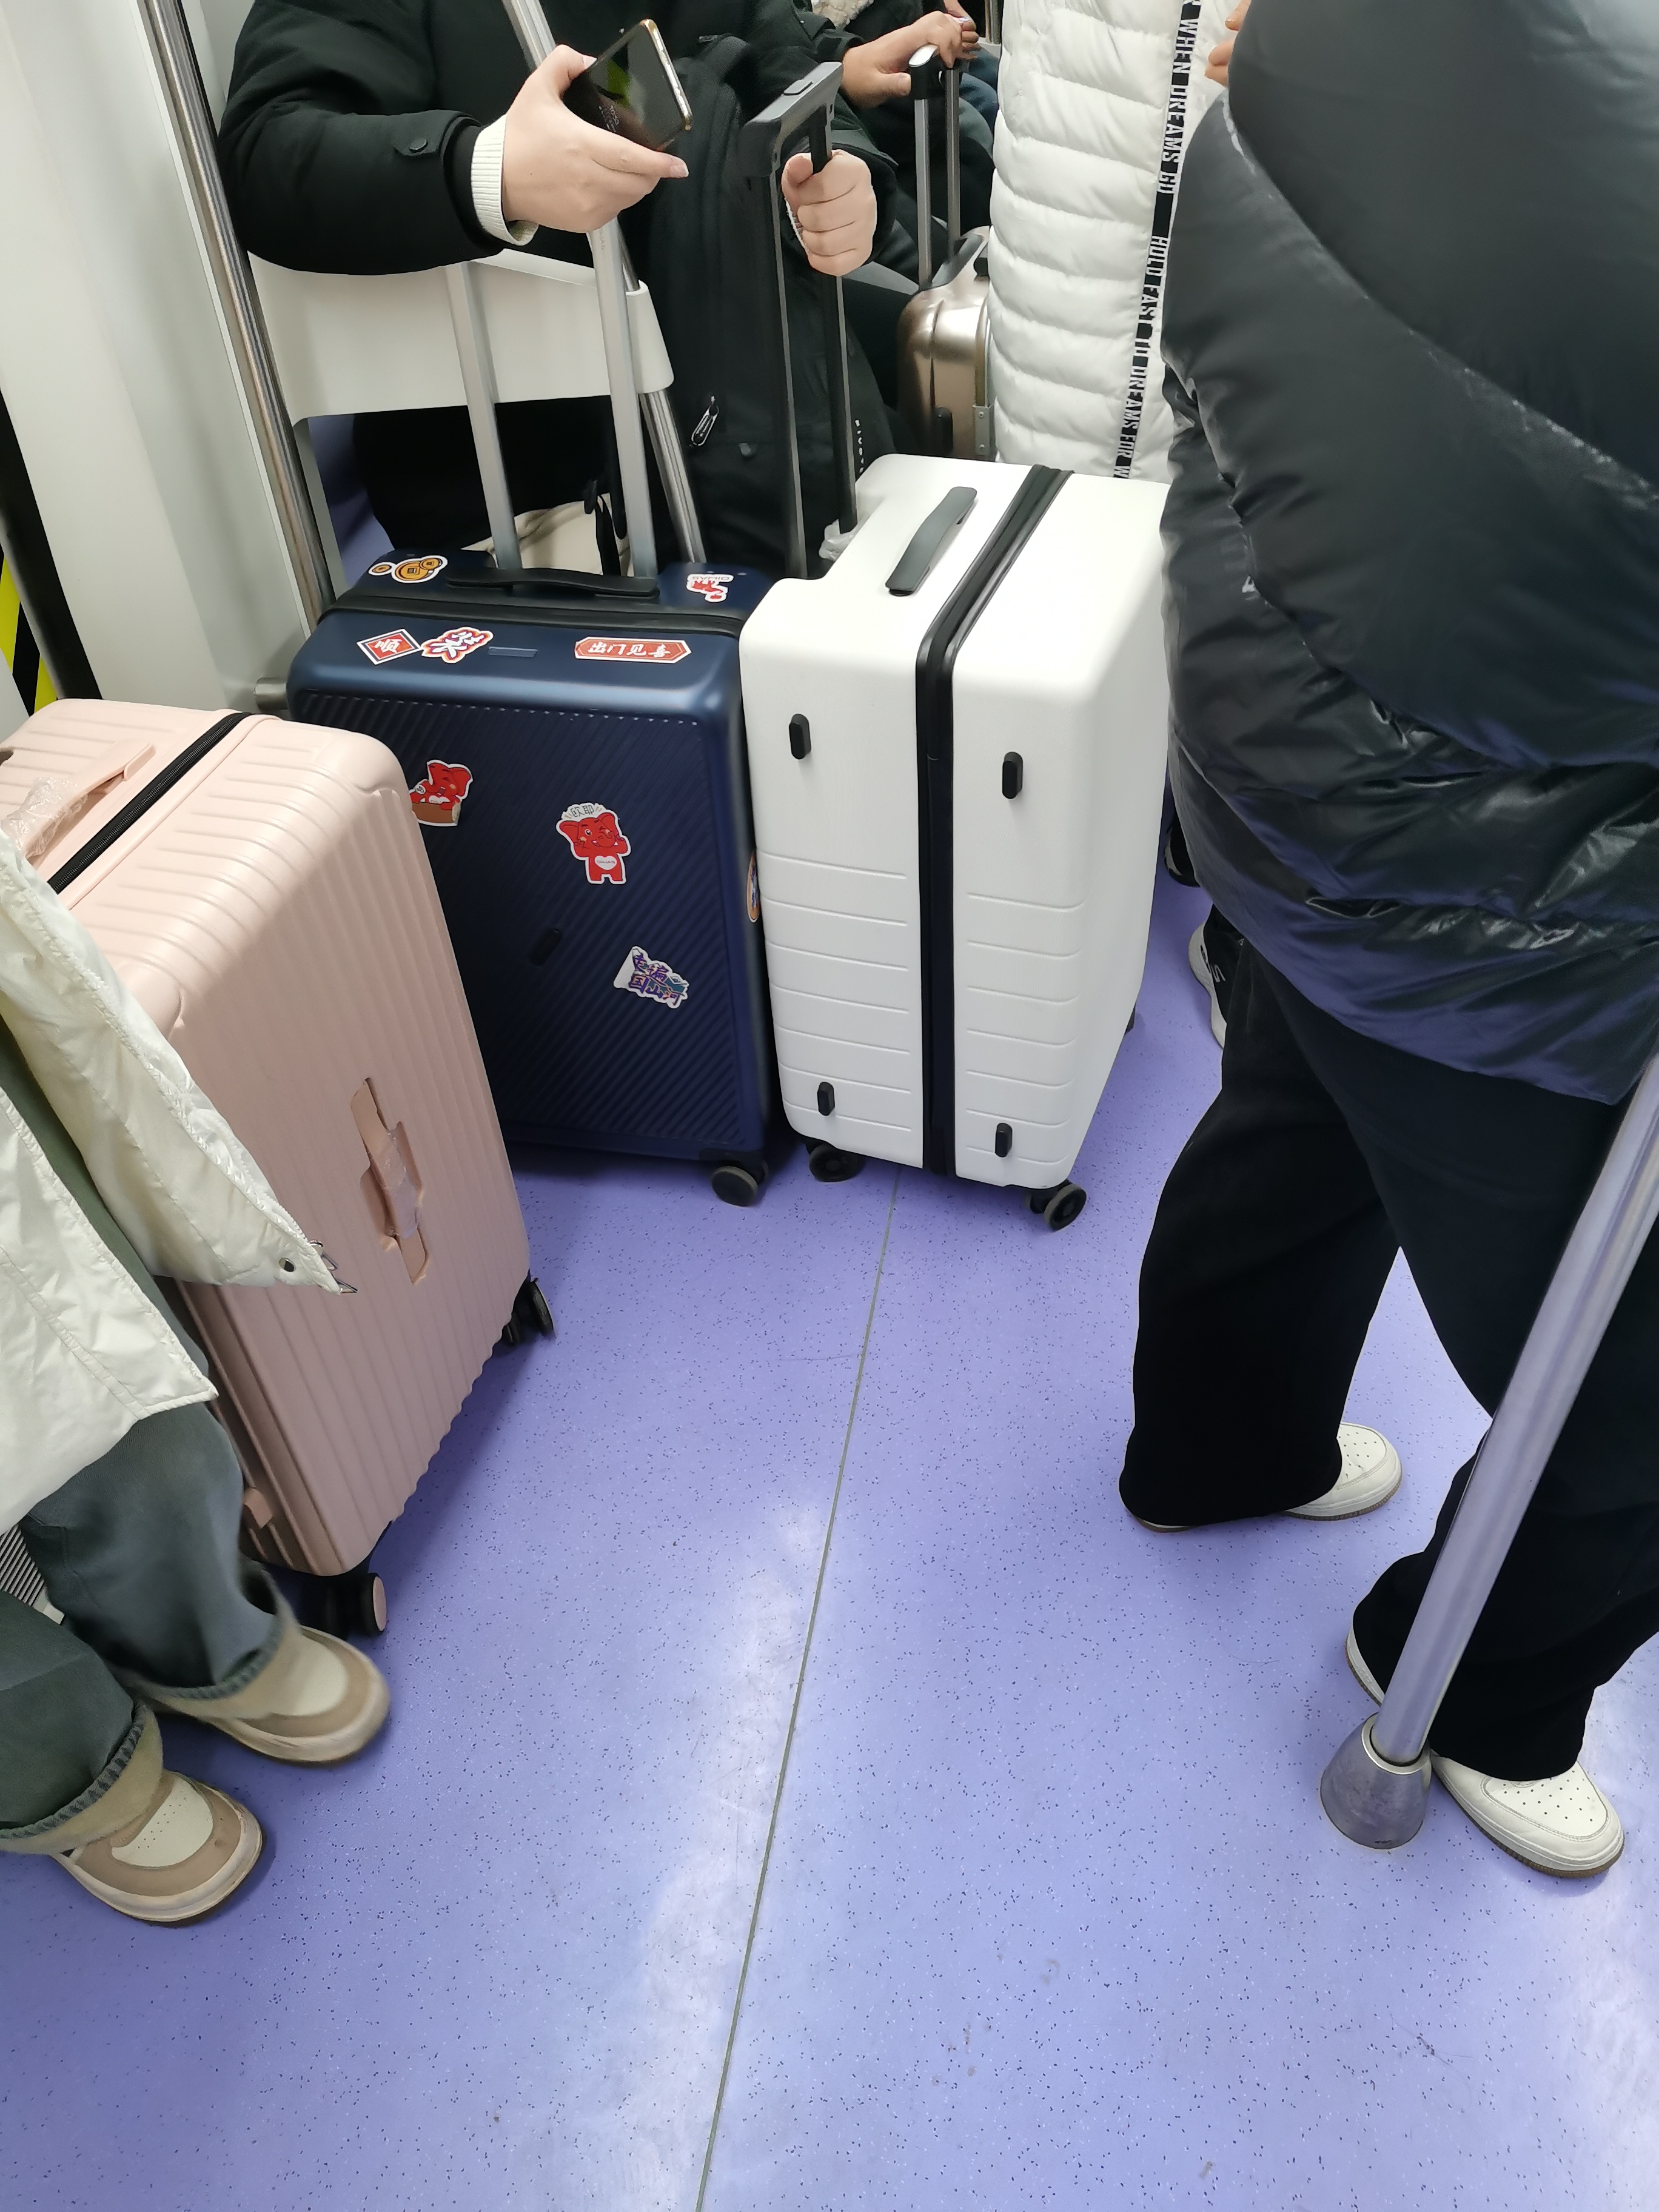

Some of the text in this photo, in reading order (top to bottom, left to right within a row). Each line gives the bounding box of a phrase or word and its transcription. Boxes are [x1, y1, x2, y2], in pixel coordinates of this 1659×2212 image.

[1171, 18, 1199, 74] WHEN
[1162, 84, 1188, 163] DREAMS
[1156, 171, 1178, 194] GO
[1145, 235, 1170, 276] HOLD
[1138, 284, 1161, 324] FAST
[1133, 338, 1151, 357] TO
[1122, 366, 1148, 429] DREAMS
[1116, 433, 1136, 459] FOR
[587, 641, 671, 659] 出门见喜
[570, 804, 594, 817] 欧耶
